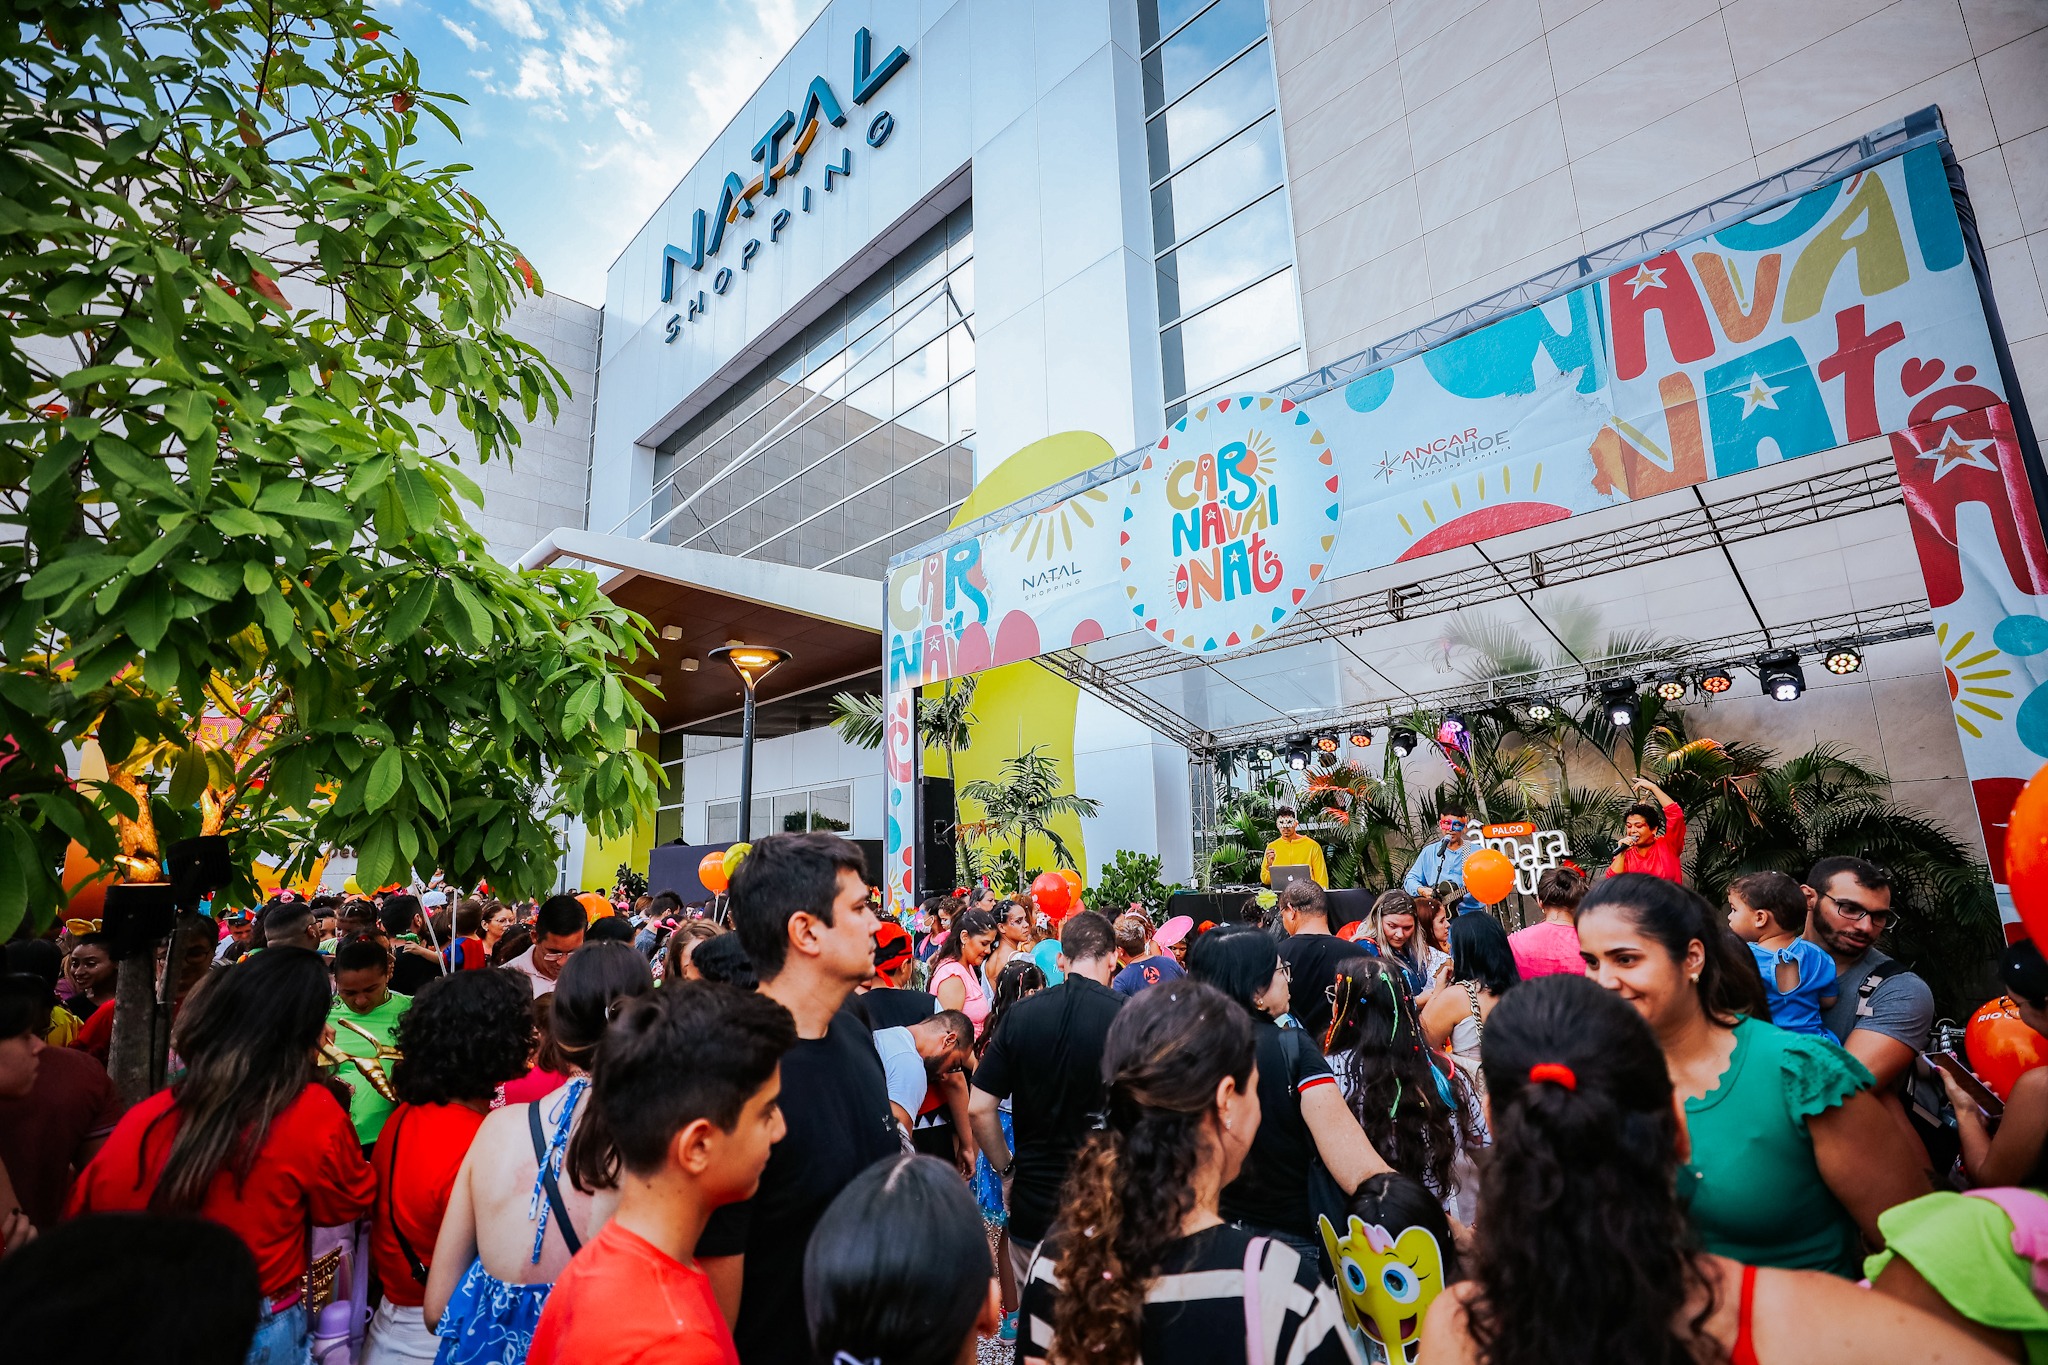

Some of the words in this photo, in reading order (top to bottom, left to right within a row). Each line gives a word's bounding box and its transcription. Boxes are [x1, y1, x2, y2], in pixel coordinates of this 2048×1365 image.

[661, 25, 910, 303] NATAL
[664, 110, 895, 345] SHOPPING
[1401, 427, 1478, 464] ANCAR
[1410, 430, 1510, 473] IVANHOE
[1412, 463, 1461, 480] shopping
[1468, 446, 1511, 462] centers
[1022, 562, 1082, 591] NATAL
[1024, 579, 1081, 601] SHOPPING
[1492, 825, 1524, 835] PALCO
[1978, 1012, 2003, 1023] RIO
